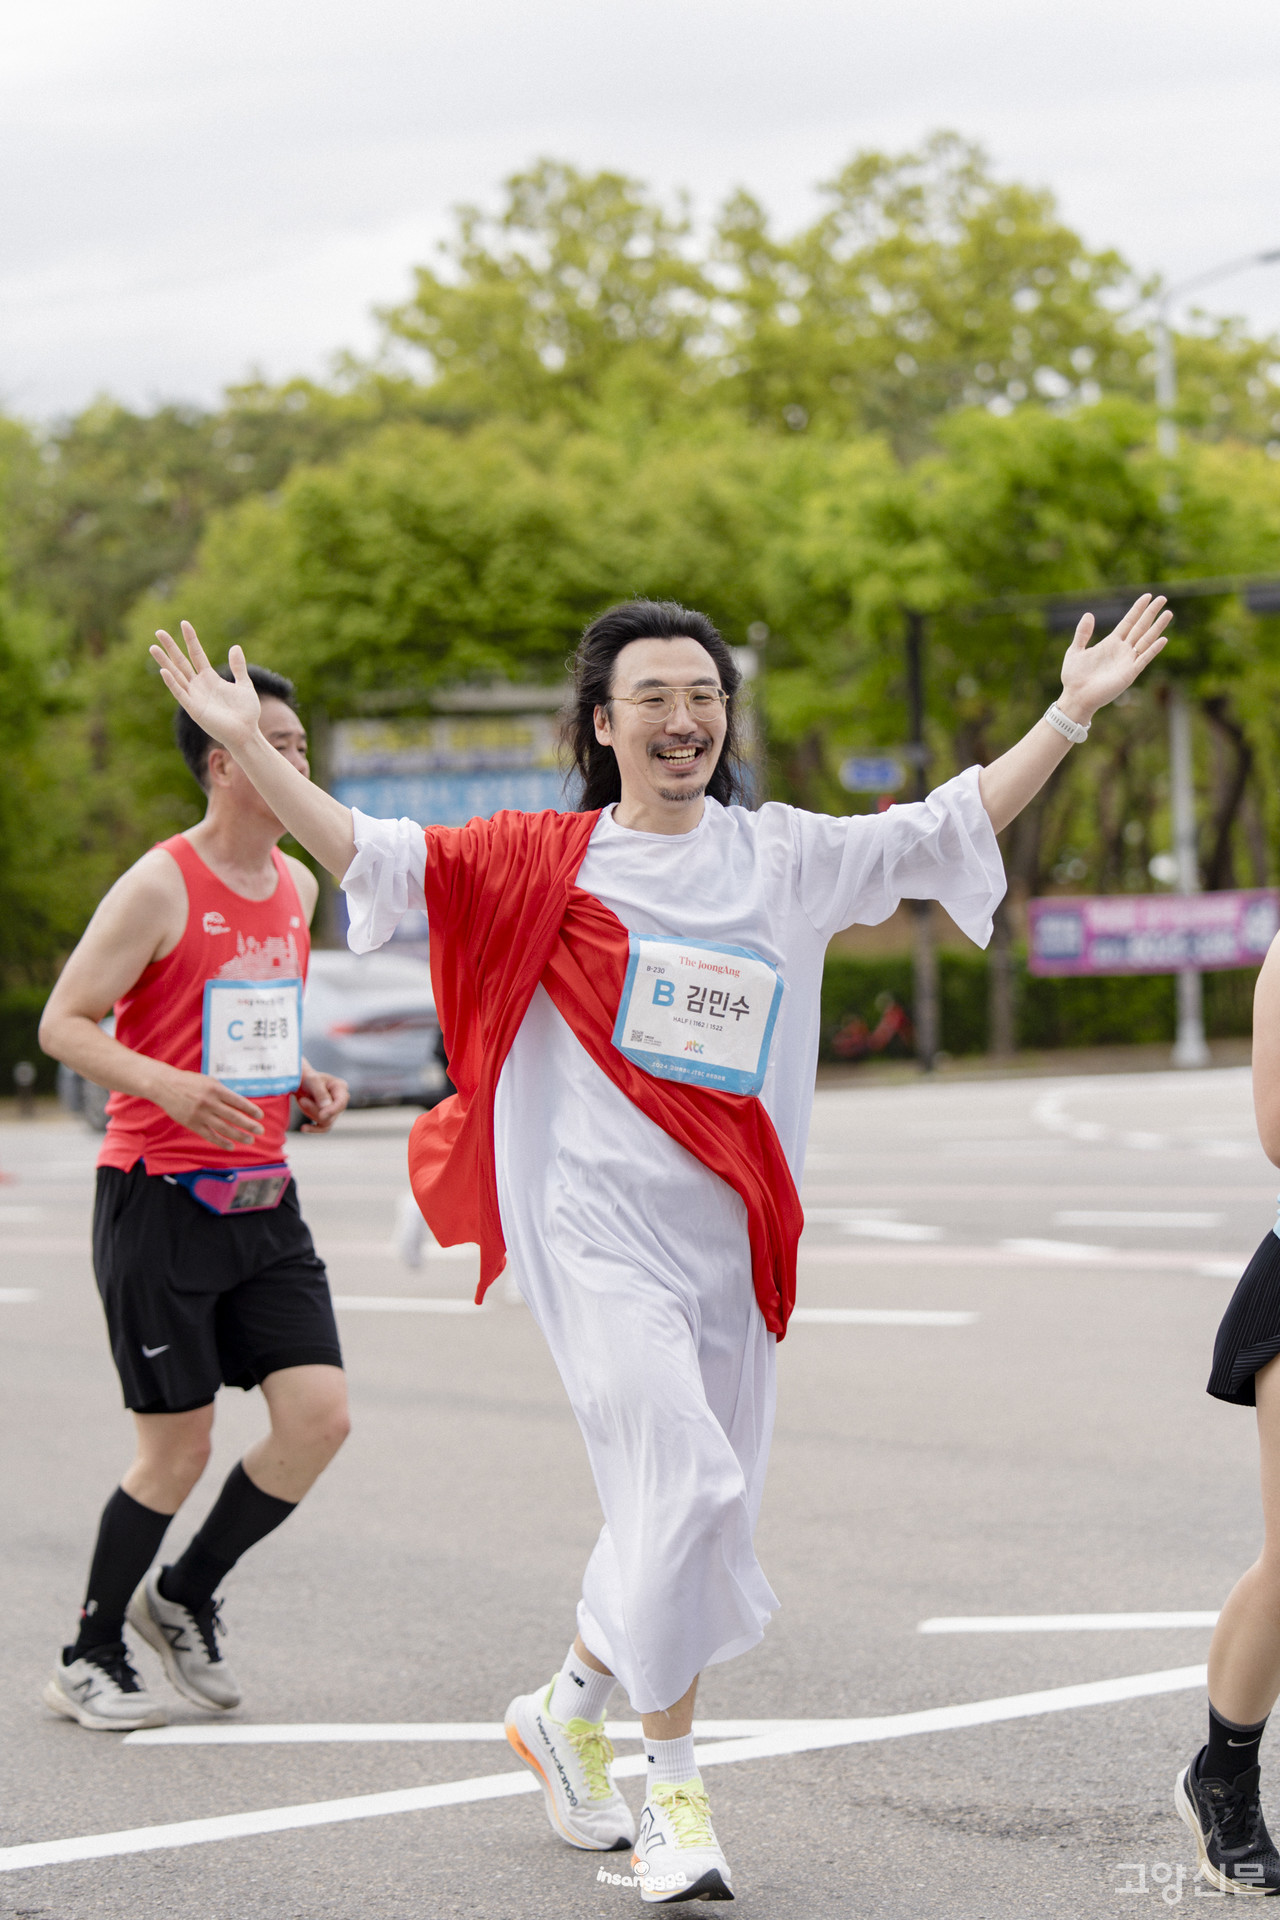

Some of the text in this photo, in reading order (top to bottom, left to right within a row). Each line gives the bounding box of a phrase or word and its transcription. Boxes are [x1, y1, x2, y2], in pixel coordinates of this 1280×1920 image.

[646, 966, 665, 974] B-230
[679, 956, 740, 977] The JoongAng
[652, 979, 749, 1021] B 김민수
[228, 1020, 244, 1041] C
[673, 1016, 688, 1024] HALF
[693, 1019, 705, 1028] 1162
[710, 1023, 723, 1031] 1522
[535, 1714, 578, 1807] new balance
